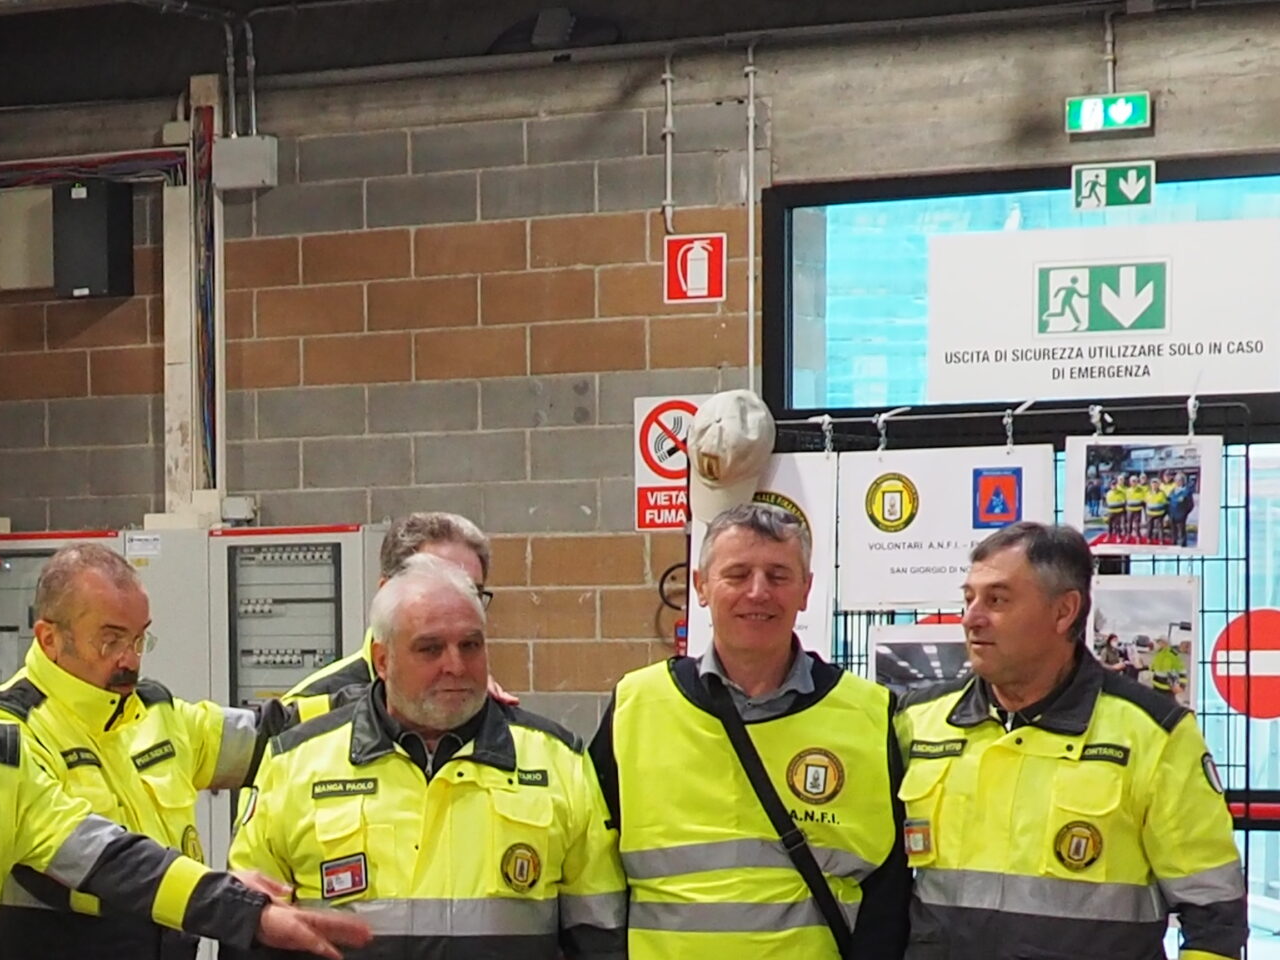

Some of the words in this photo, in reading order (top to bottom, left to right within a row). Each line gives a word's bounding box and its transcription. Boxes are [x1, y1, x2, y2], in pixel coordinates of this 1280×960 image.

[944, 349, 990, 364] USCITA
[994, 349, 1008, 363] DI
[1011, 347, 1083, 362] SICUREZZA
[1088, 344, 1164, 359] UTILIZZARE
[1168, 342, 1204, 357] SOLO
[1208, 342, 1222, 355] IN
[1226, 340, 1264, 354] CASO
[1051, 367, 1066, 380] DI
[1069, 364, 1151, 380] EMERGENZA
[647, 491, 687, 506] VIETA
[645, 509, 687, 524] FUMA
[868, 541, 923, 551] VOLONTARI
[890, 567, 908, 575] SAN
[910, 566, 948, 575] GIORGIO
[1084, 747, 1124, 759] ONTARIO
[346, 781, 375, 791] PAOLO
[789, 808, 840, 824] A.N.F.I.
